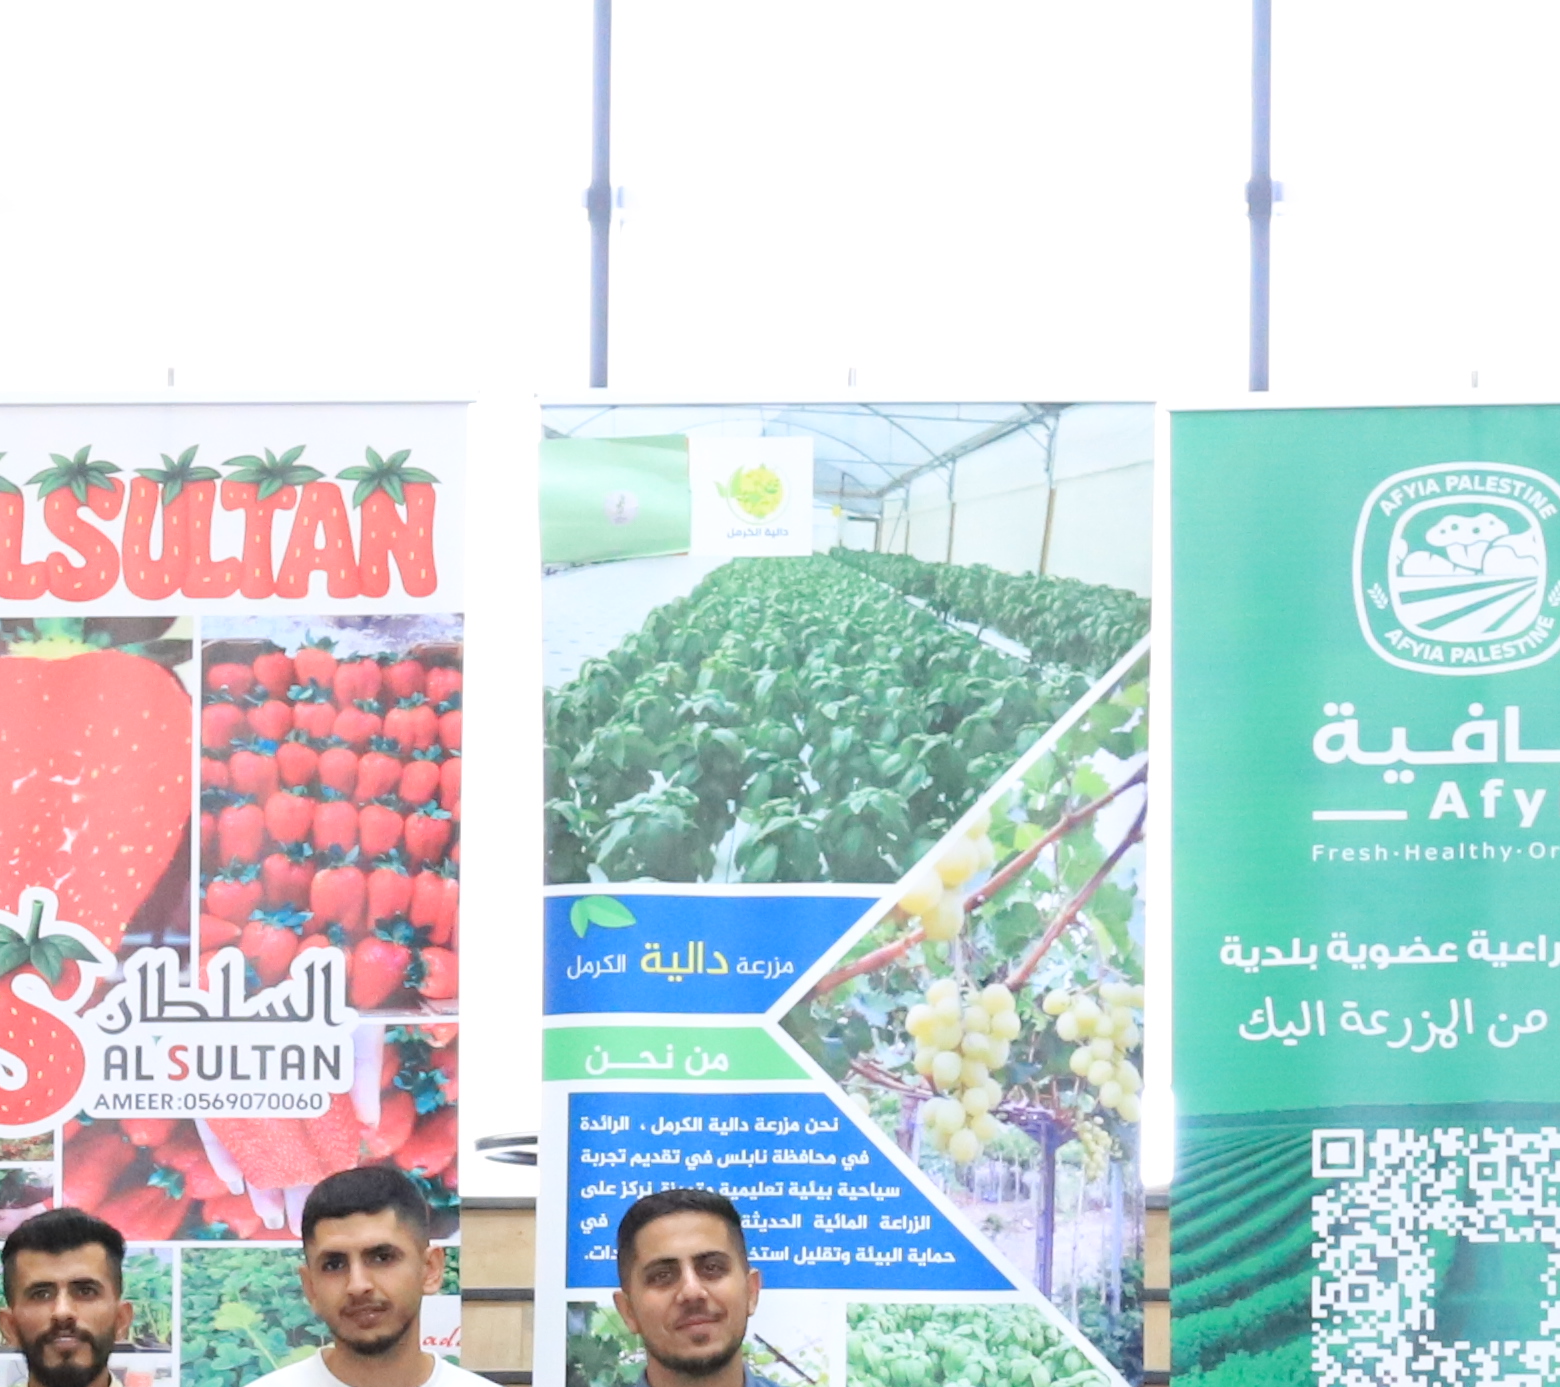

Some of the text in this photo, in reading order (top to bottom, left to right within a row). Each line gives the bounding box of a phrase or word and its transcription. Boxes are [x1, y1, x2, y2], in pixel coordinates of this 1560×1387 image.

[1379, 474, 1557, 520] AFYIA PALESTINE
[1384, 613, 1555, 664] AFYIA PALESTINE
[1219, 935, 1318, 973] بلدية
[1327, 932, 1458, 970] عضوية
[567, 940, 795, 985] مزرعة دالية الكرمل
[96, 958, 345, 1034] السلطان
[1238, 996, 1326, 1047] اليك
[1340, 996, 1475, 1053] المزرعة
[1488, 1005, 1549, 1047] من
[167, 1043, 342, 1081] SULTAN
[586, 1042, 729, 1074] من نحن
[580, 1115, 629, 1133] الرائدة
[651, 1116, 703, 1134] الكرمل
[708, 1117, 749, 1133] دالية
[754, 1117, 800, 1135] مزرعة
[805, 1116, 840, 1134] نحن
[580, 1148, 870, 1170] في محافظة نابلس في تقديم تجربة
[580, 1180, 617, 1199] على
[720, 1181, 784, 1200] تعليمية
[788, 1181, 832, 1200] بيئية
[837, 1182, 900, 1200] سياحية
[580, 1211, 931, 1235] الزراعة المائية الحديثة في
[793, 1246, 850, 1267] وتقليل
[855, 1247, 902, 1266] البيئة
[908, 1248, 956, 1267] حماية
